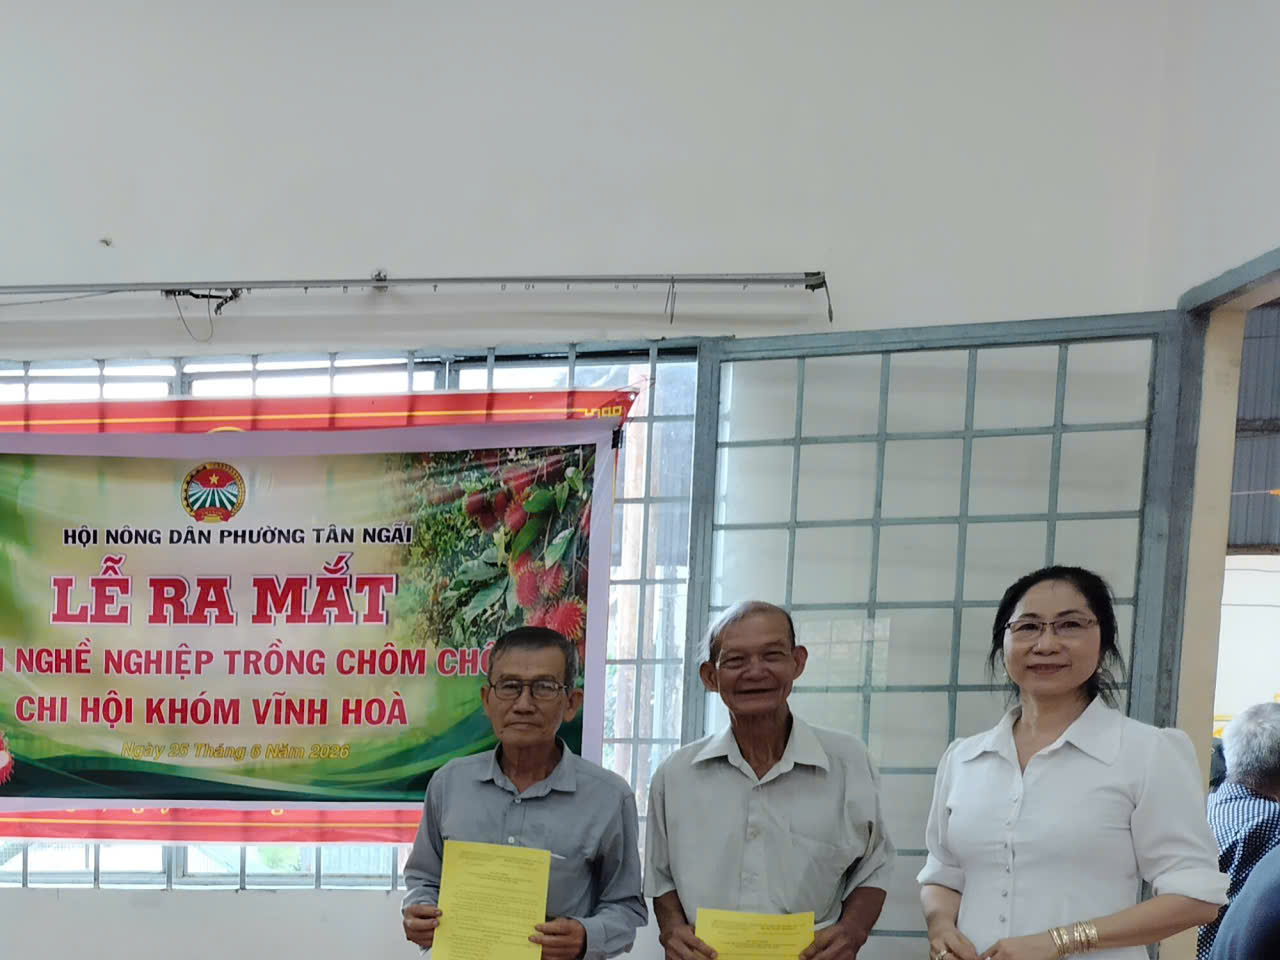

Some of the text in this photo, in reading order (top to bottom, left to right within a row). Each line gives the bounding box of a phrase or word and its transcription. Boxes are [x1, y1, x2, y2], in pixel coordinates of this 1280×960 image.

[63, 522, 413, 548] HỘI NÔNG DÂN PHƯỜNG TÂN NGÃI
[51, 552, 397, 625] LỄ RA MẮT
[15, 637, 92, 674] NGHỀ
[104, 643, 214, 680] NGHIỆP
[223, 638, 326, 675] TRỒNG
[336, 642, 426, 675] CHÔM
[437, 641, 494, 675] CH
[15, 689, 408, 728] CHI HỘI KHÓM VĨNH HOÀ
[121, 743, 165, 760] Ngày
[194, 743, 246, 760] Tháng
[250, 743, 262, 759] 6
[265, 743, 304, 759] Năm
[310, 743, 350, 760] 2026
